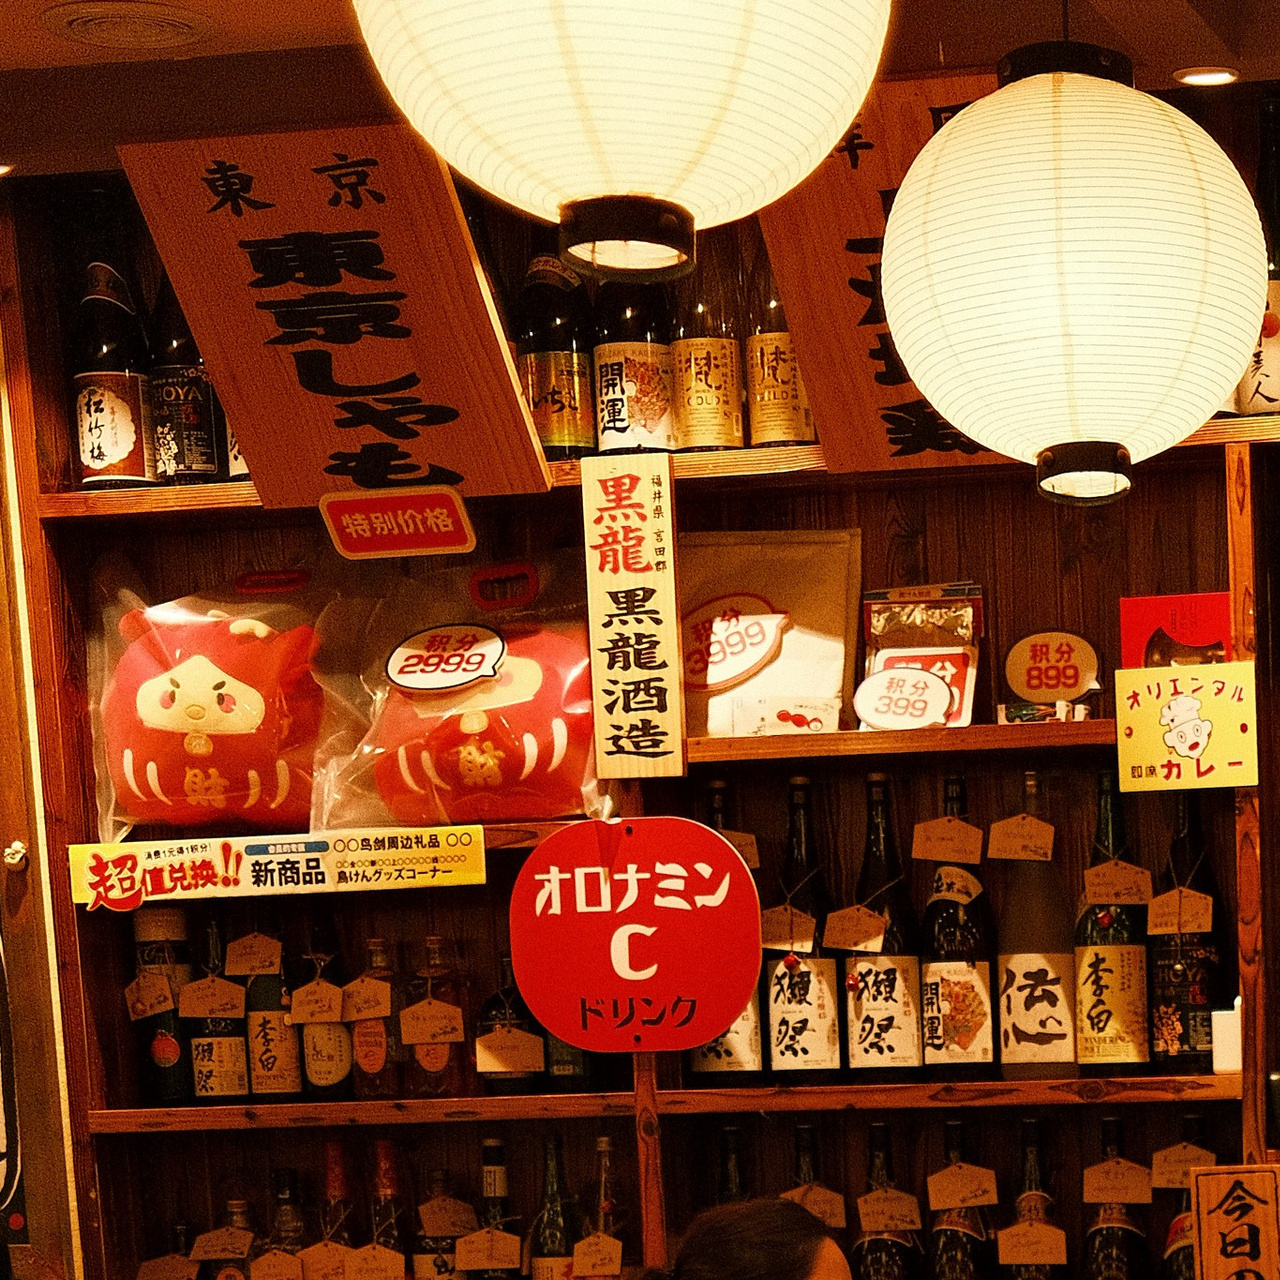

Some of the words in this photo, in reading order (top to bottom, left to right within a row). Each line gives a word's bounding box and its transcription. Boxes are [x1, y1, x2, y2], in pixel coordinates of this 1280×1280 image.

[201, 152, 387, 218] 東京
[600, 361, 630, 435] 開運
[341, 507, 454, 539] 特别价格
[590, 473, 655, 575] 黒龍
[398, 653, 486, 675] 2999
[424, 632, 480, 653] 积分
[1029, 642, 1075, 664] 积分
[597, 586, 674, 759] 黒龍酒造
[886, 677, 929, 697] 积分
[1026, 665, 1079, 690] 899
[1126, 677, 1245, 710] オリエンタル
[875, 696, 928, 718] 399
[1160, 758, 1243, 781] カレー
[251, 857, 326, 887] 新商品
[534, 862, 730, 917] オロナミン
[610, 924, 658, 980] C
[581, 995, 697, 1031] ドリンク
[773, 970, 813, 1058] 獺祭
[857, 968, 899, 1055] 獺祭
[924, 980, 945, 1051] 開運
[1082, 953, 1113, 1035] 李白
[256, 1016, 277, 1072] 李白
